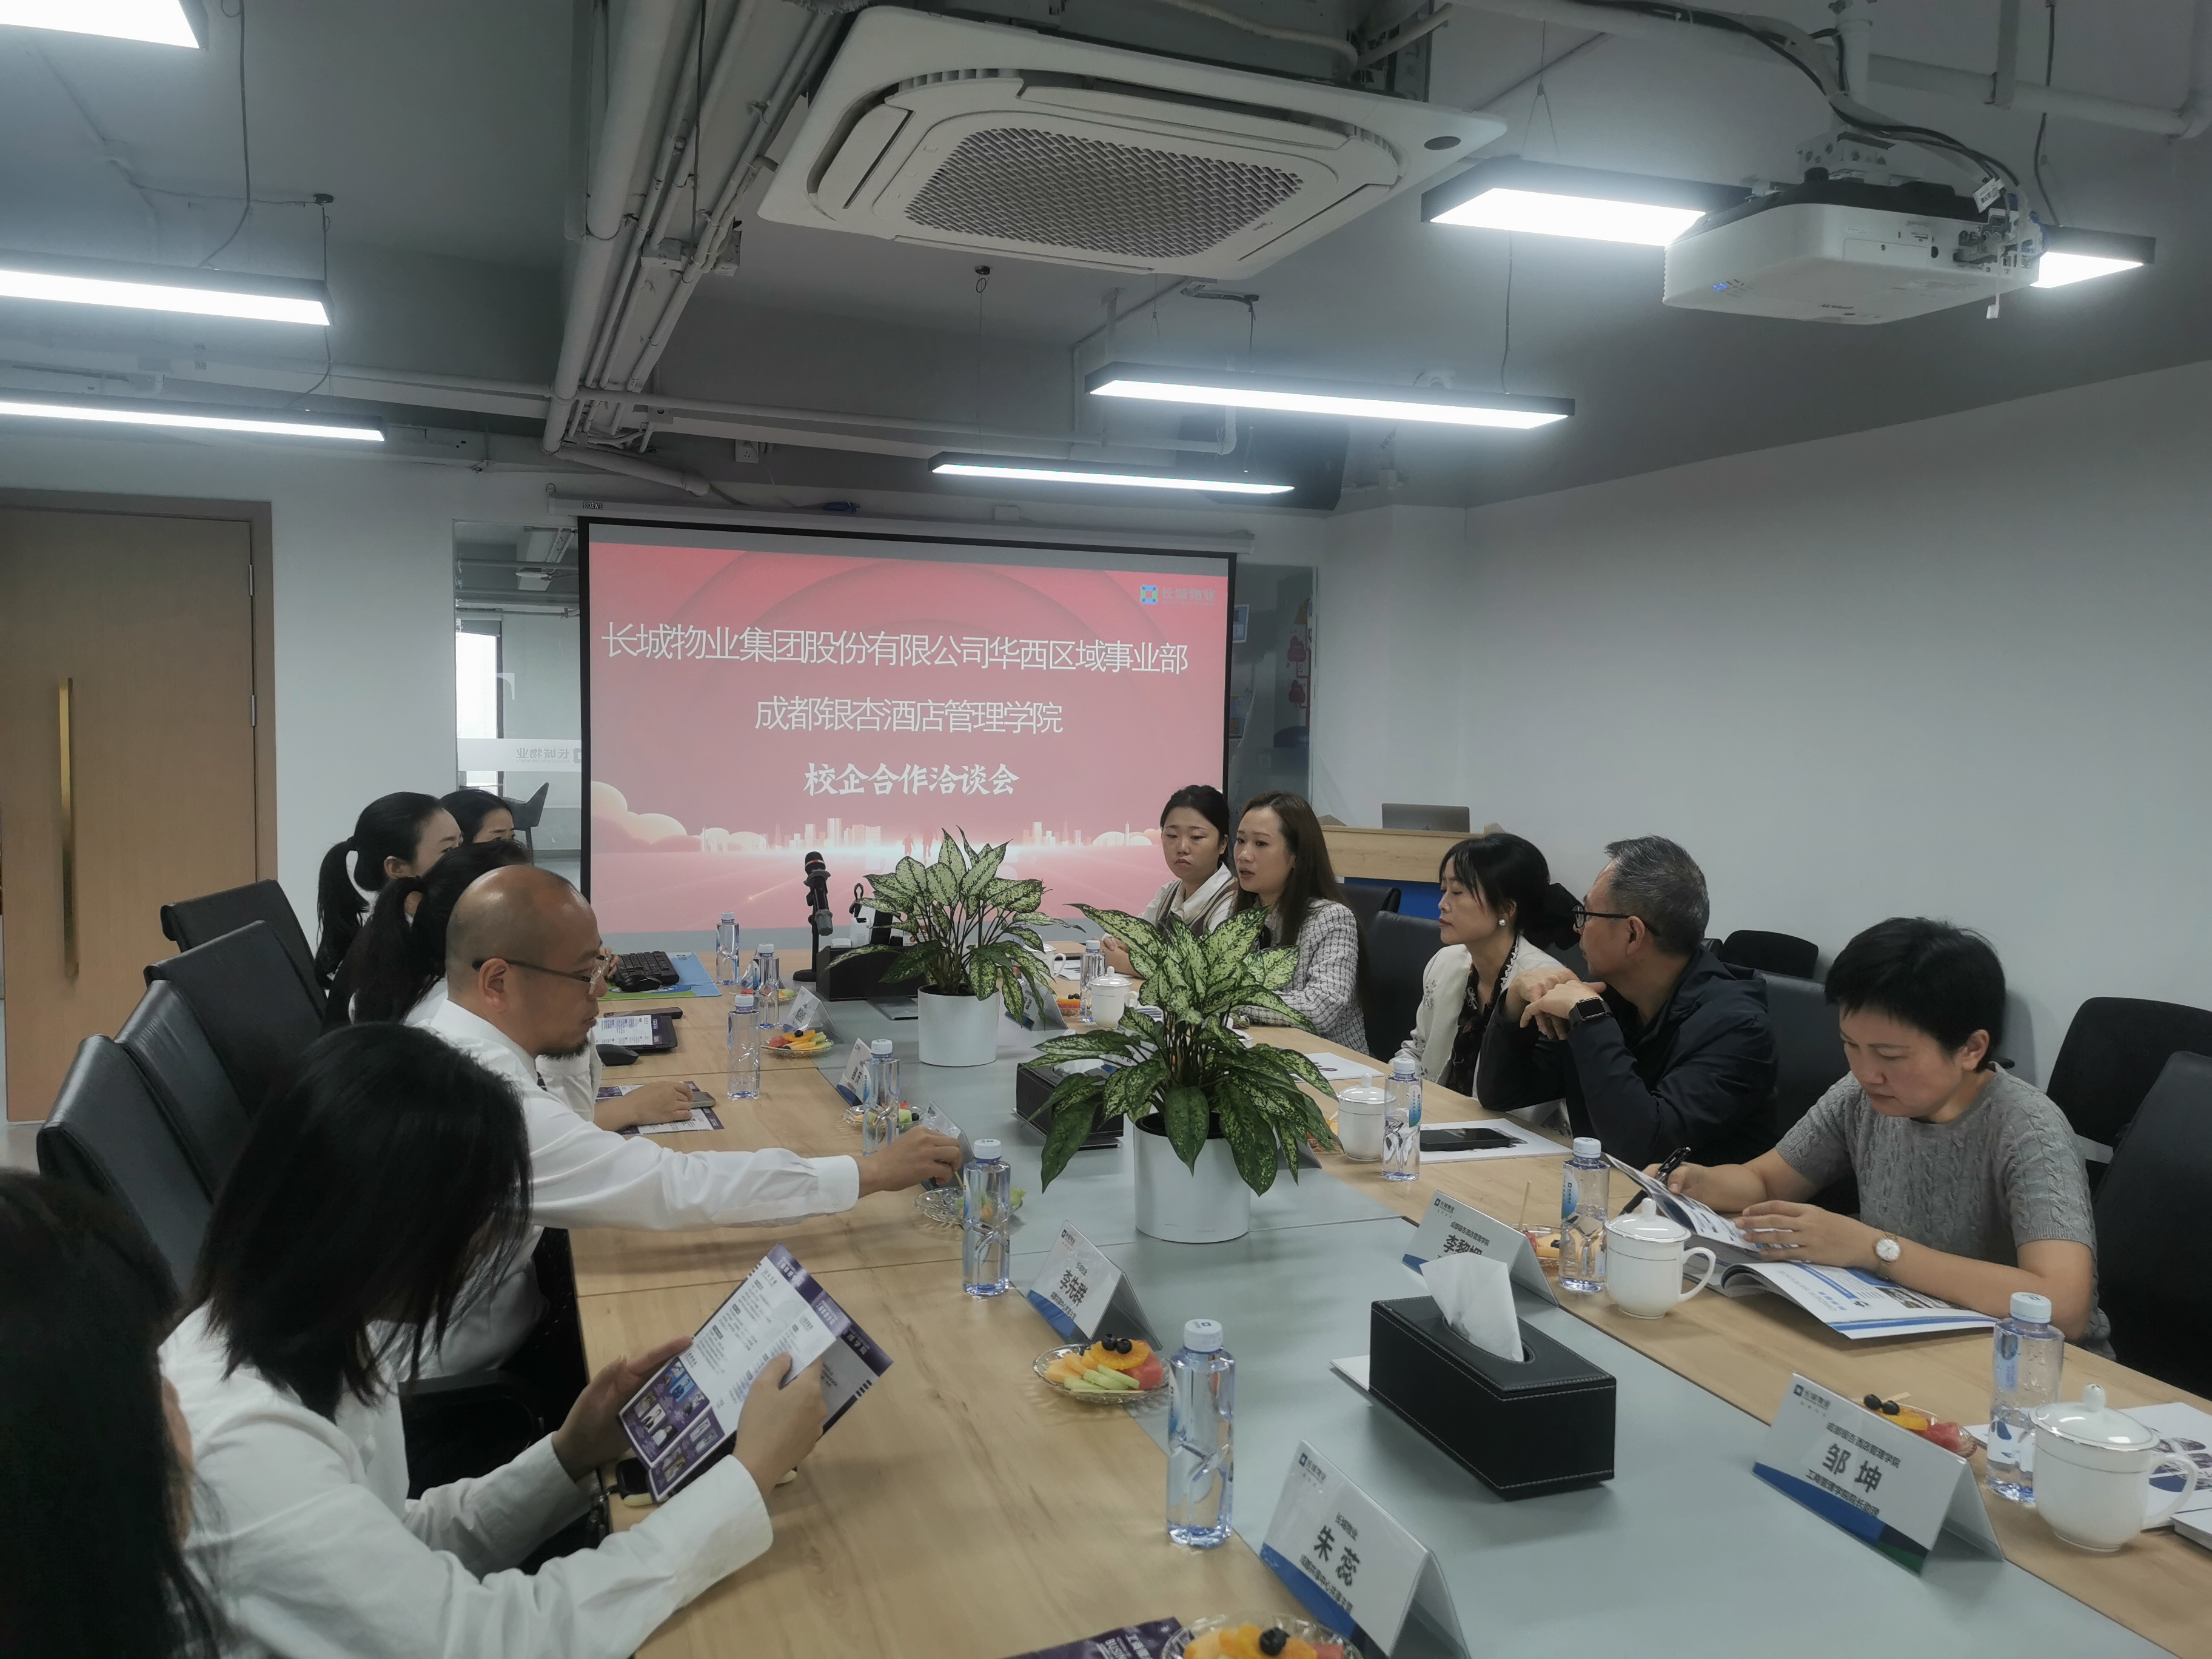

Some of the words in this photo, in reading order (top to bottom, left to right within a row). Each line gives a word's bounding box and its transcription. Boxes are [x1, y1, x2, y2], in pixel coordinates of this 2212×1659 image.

[602, 621, 1188, 675] 长城物业集团股份有限公司华西区域事业部
[754, 695, 1064, 734] 成都银杏酒店管理学院
[803, 762, 1020, 796] 校企合作洽谈会
[1059, 1269, 1088, 1307] 李先群
